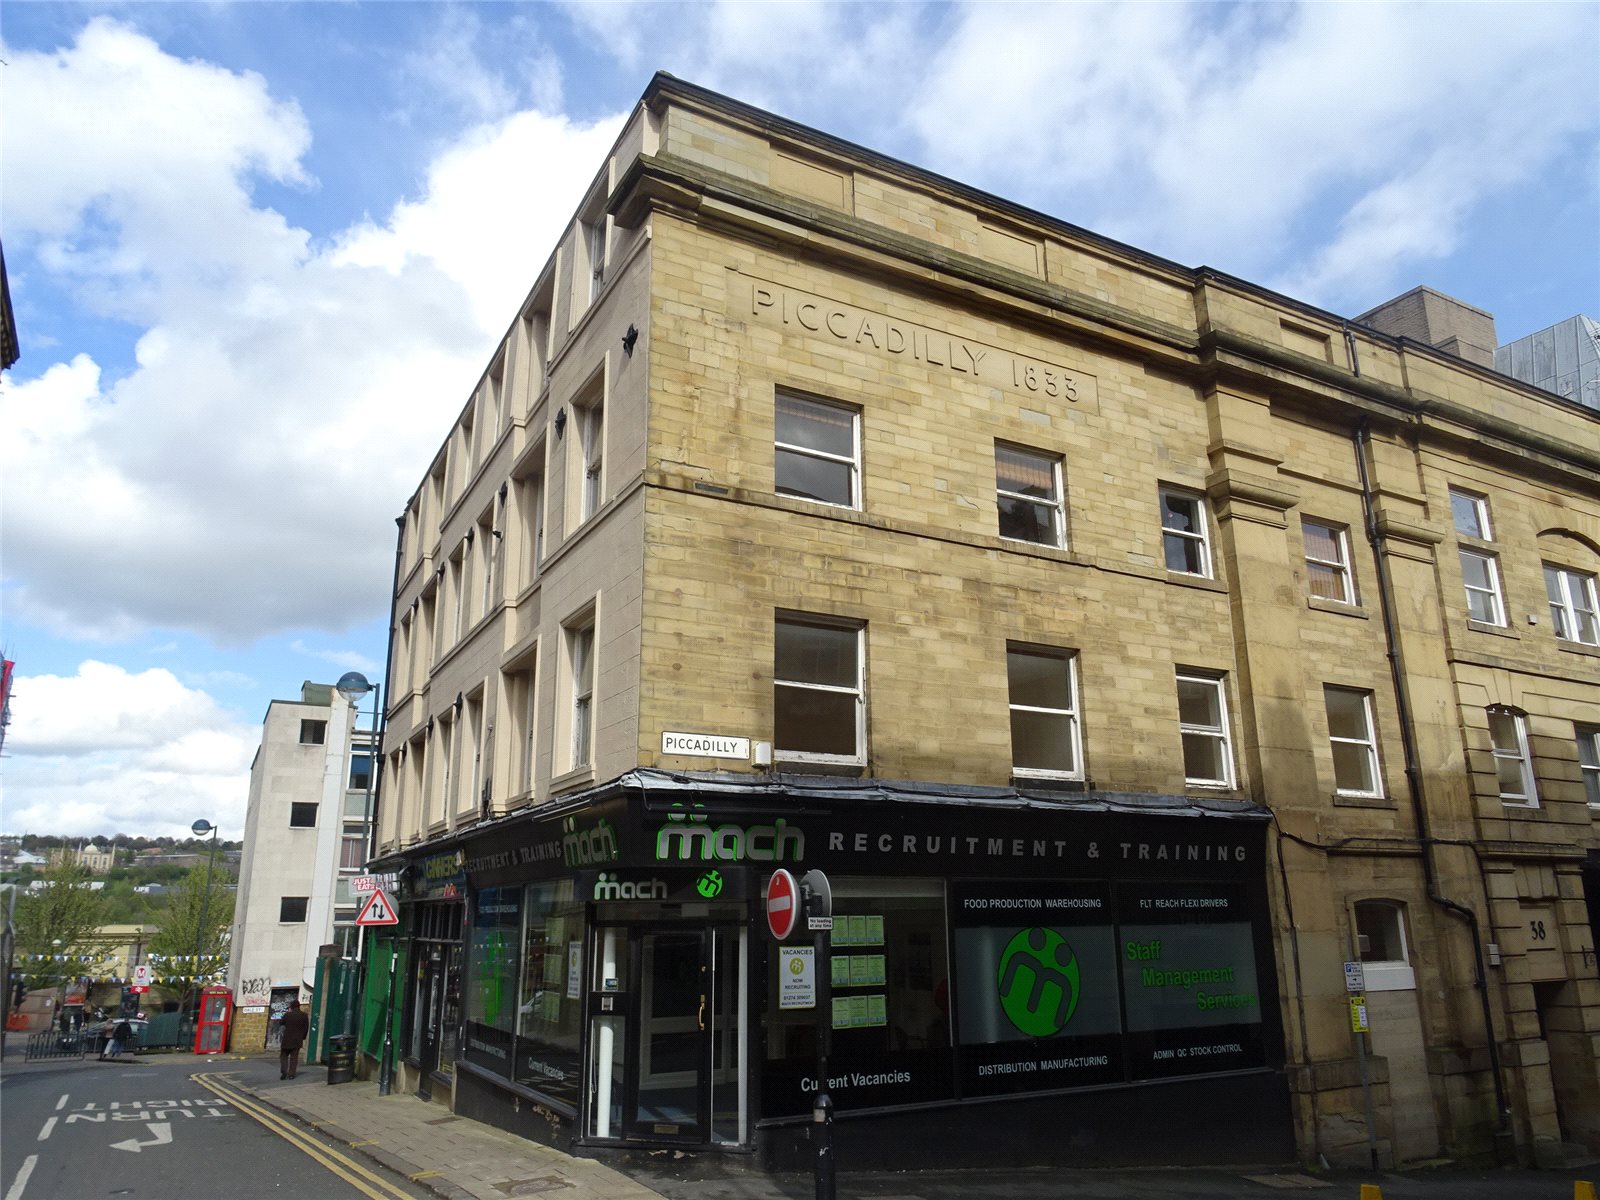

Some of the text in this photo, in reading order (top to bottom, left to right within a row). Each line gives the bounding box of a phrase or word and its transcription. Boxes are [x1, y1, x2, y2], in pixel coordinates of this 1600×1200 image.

[752, 284, 1079, 403] PICCADILLY 1833
[666, 737, 738, 753] PICCADILLY
[656, 803, 805, 862] mach
[520, 841, 562, 864] TRAINING
[829, 832, 1246, 861] RECRUITMENT & TRAINING
[353, 877, 371, 885] JUST
[594, 873, 668, 900] mach
[964, 898, 1102, 909] FOOD PRODUCTION WAREHOUSING
[1140, 898, 1229, 908] FLT REACH FLEXI DRIVERS
[1530, 920, 1546, 940] 38
[1126, 940, 1160, 960] Staff
[1142, 967, 1234, 989] Management
[1153, 1043, 1243, 1060] ADMIN QC STOCK CONTROL
[979, 1055, 1108, 1076] DISTRIBUTION MANUFACTURING
[801, 1069, 911, 1092] Cuent Vacancies
